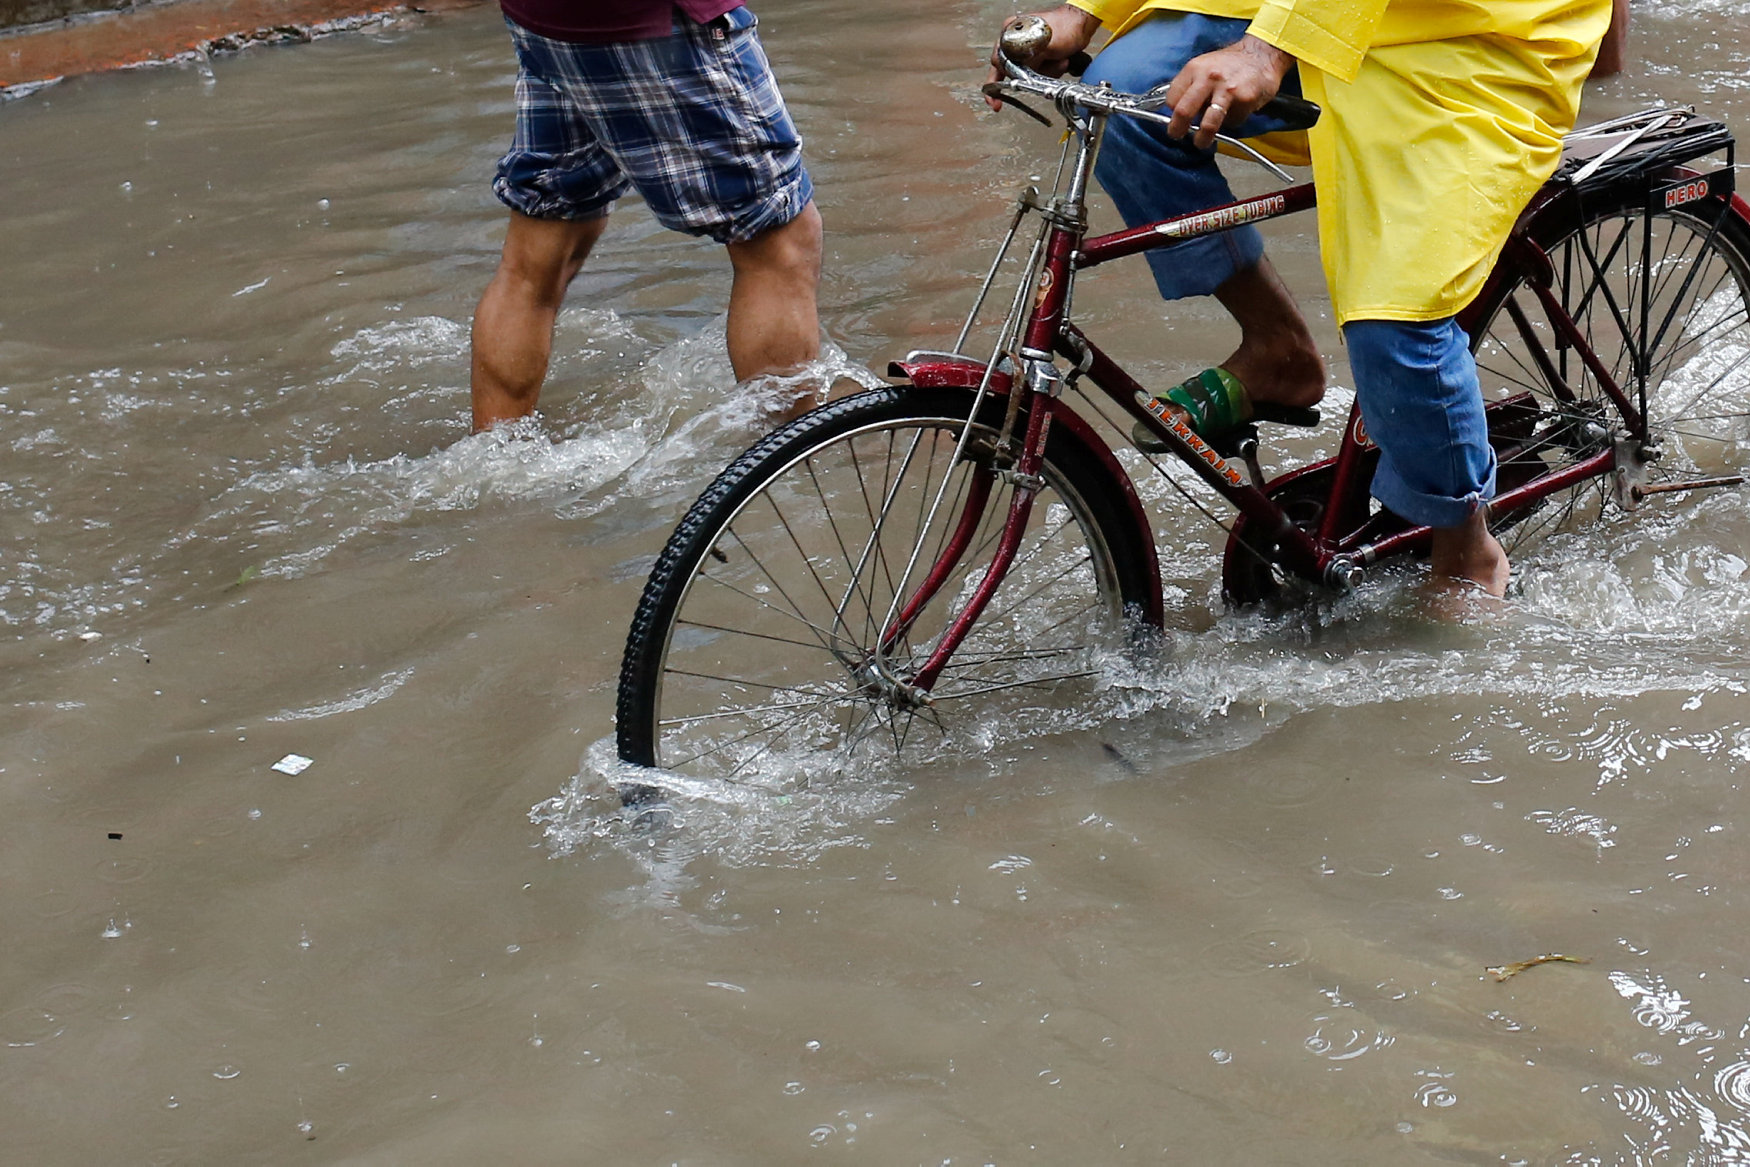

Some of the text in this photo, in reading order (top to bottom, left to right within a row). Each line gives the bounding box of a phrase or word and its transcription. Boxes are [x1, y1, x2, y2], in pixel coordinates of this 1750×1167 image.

[1665, 180, 1709, 209] HERO
[1179, 195, 1286, 236] OVER SIZE TUBING
